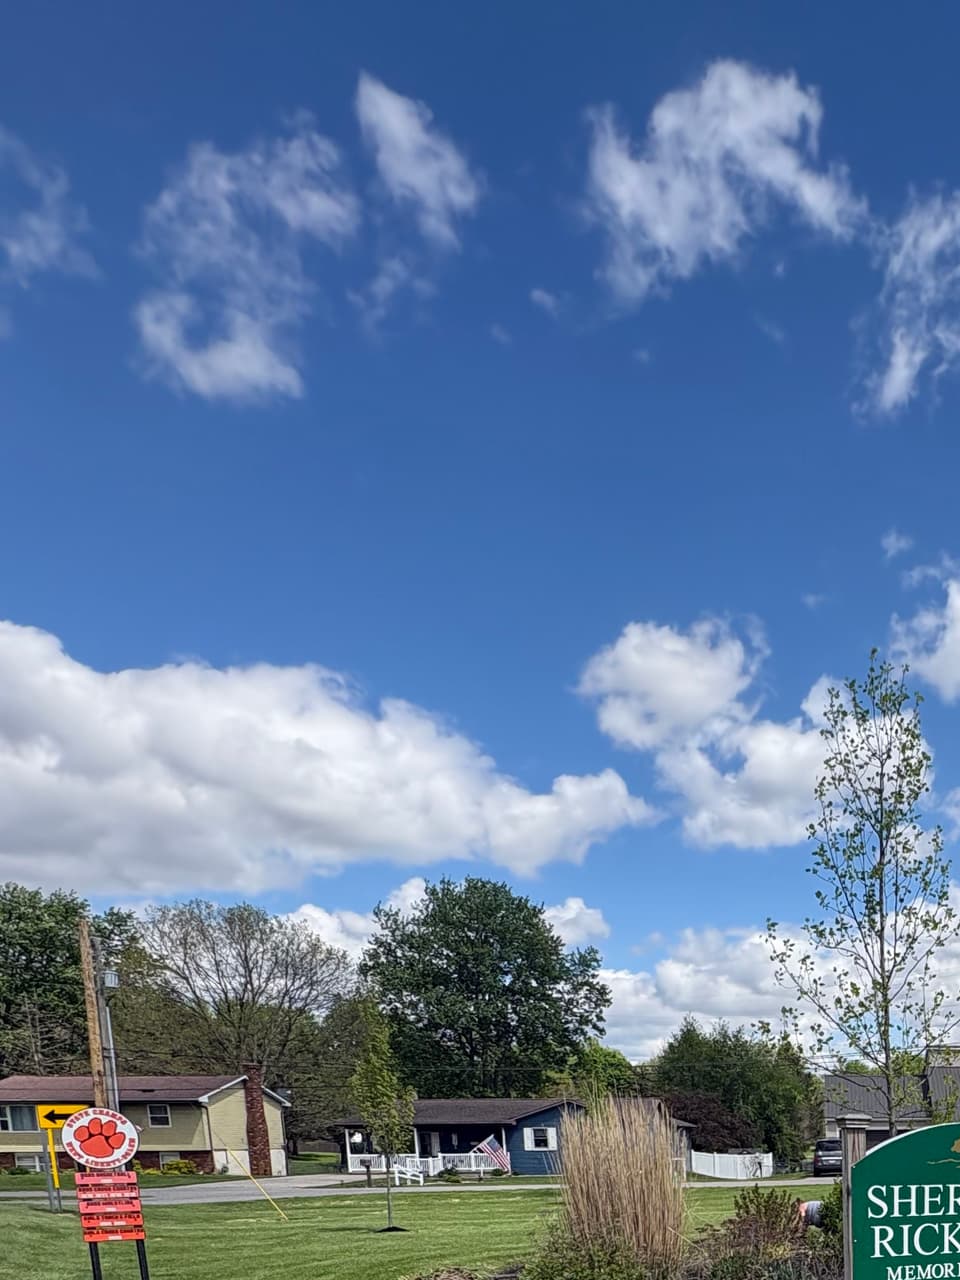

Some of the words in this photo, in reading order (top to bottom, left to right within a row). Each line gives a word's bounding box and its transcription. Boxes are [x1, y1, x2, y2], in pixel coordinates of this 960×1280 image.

[66, 1110, 90, 1128] STATE
[92, 1109, 128, 1125] CHAMPS
[66, 1142, 85, 1160] WEST
